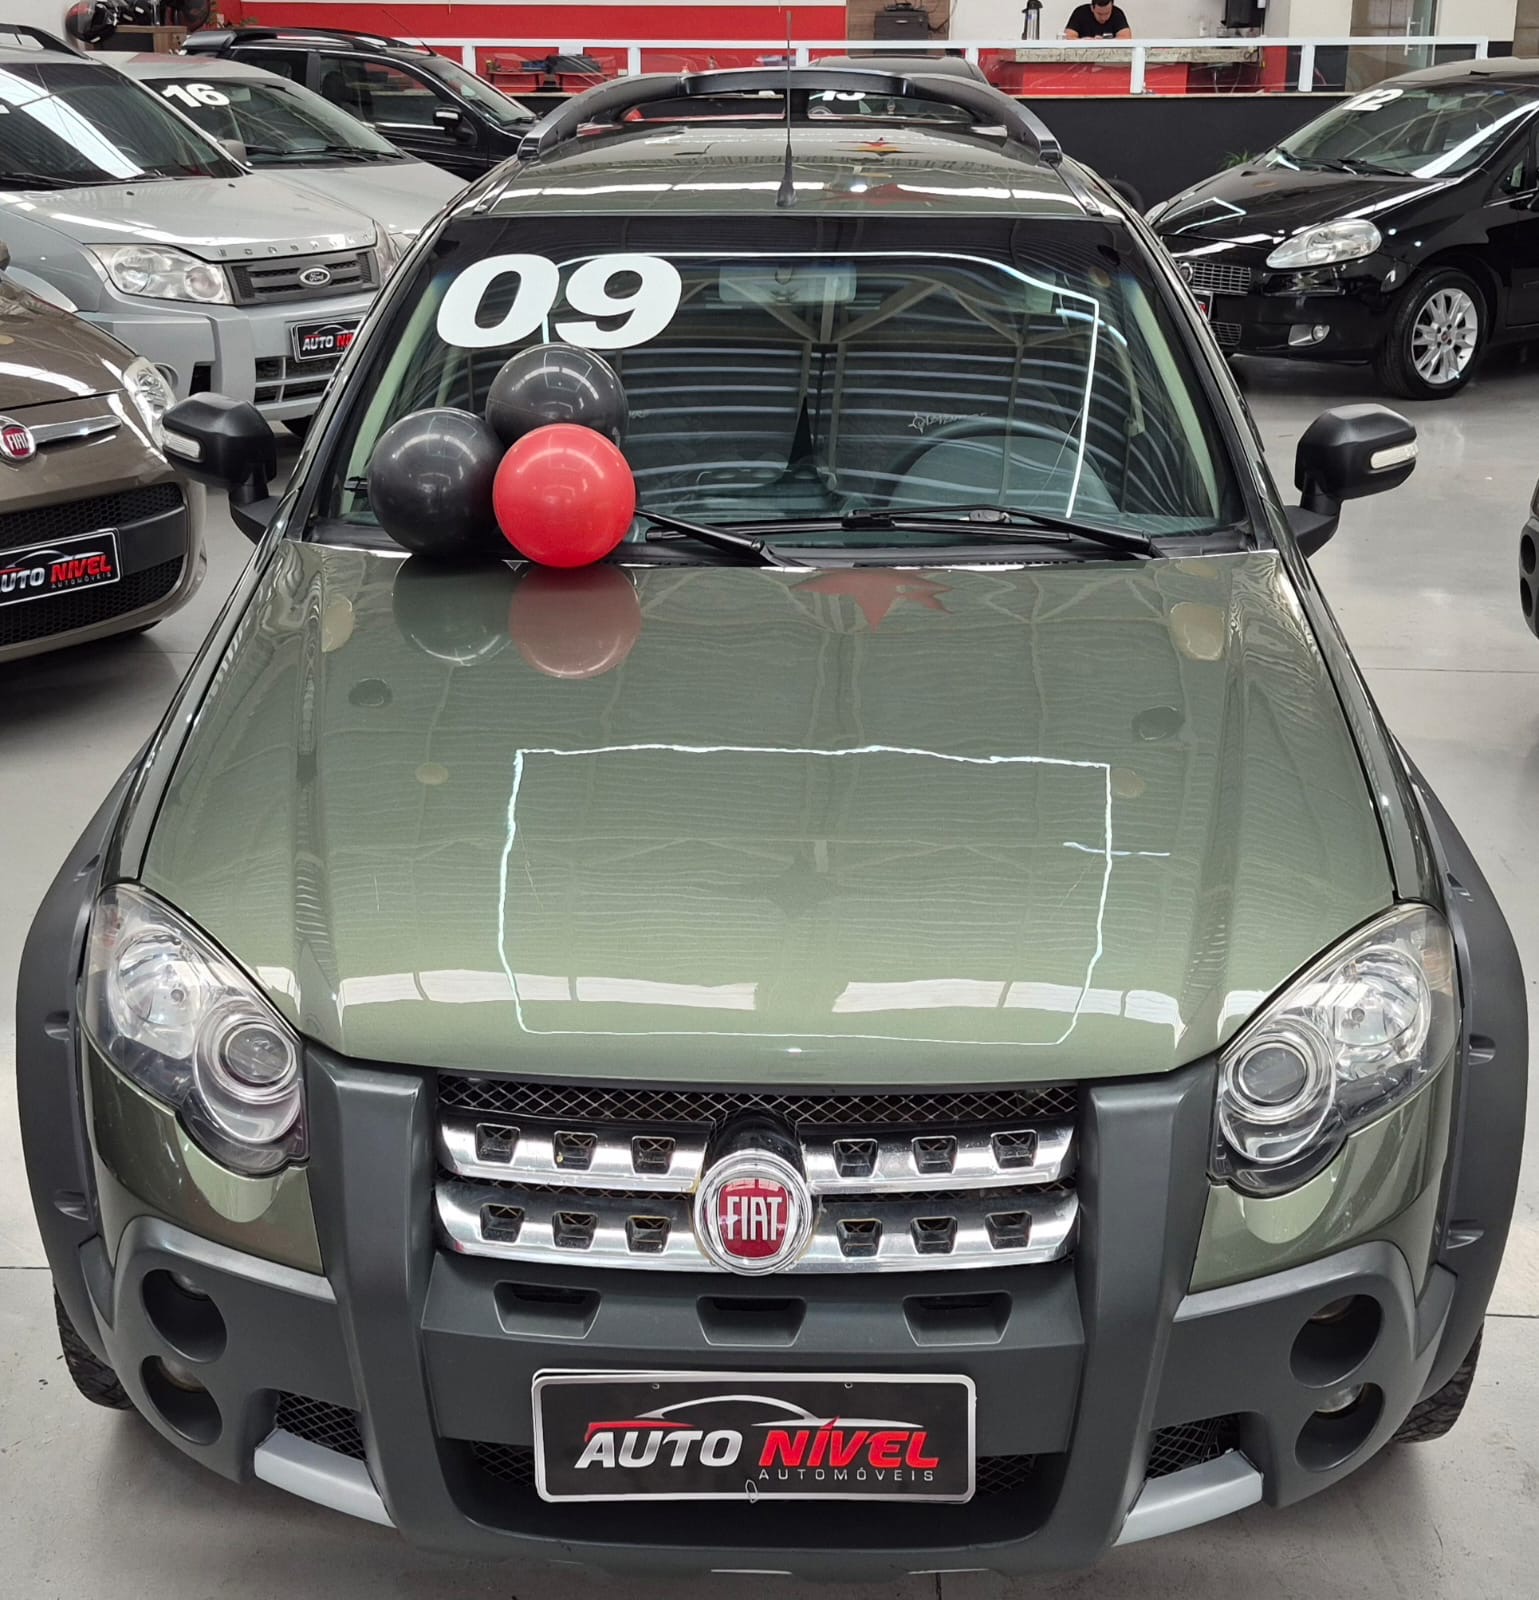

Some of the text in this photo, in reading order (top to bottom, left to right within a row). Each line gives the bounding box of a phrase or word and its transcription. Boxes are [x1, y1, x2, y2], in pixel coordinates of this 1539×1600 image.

[160, 82, 230, 107] 16
[1341, 88, 1404, 111] 12
[436, 253, 682, 349] 09
[302, 335, 334, 351] AUTO
[5, 431, 29, 451] FIAT
[0, 567, 45, 593] UTO
[726, 1195, 783, 1241] FIAT
[574, 1416, 941, 1469] AUTO NÍVEL
[758, 1466, 934, 1481] AUTOMÓVEIS
